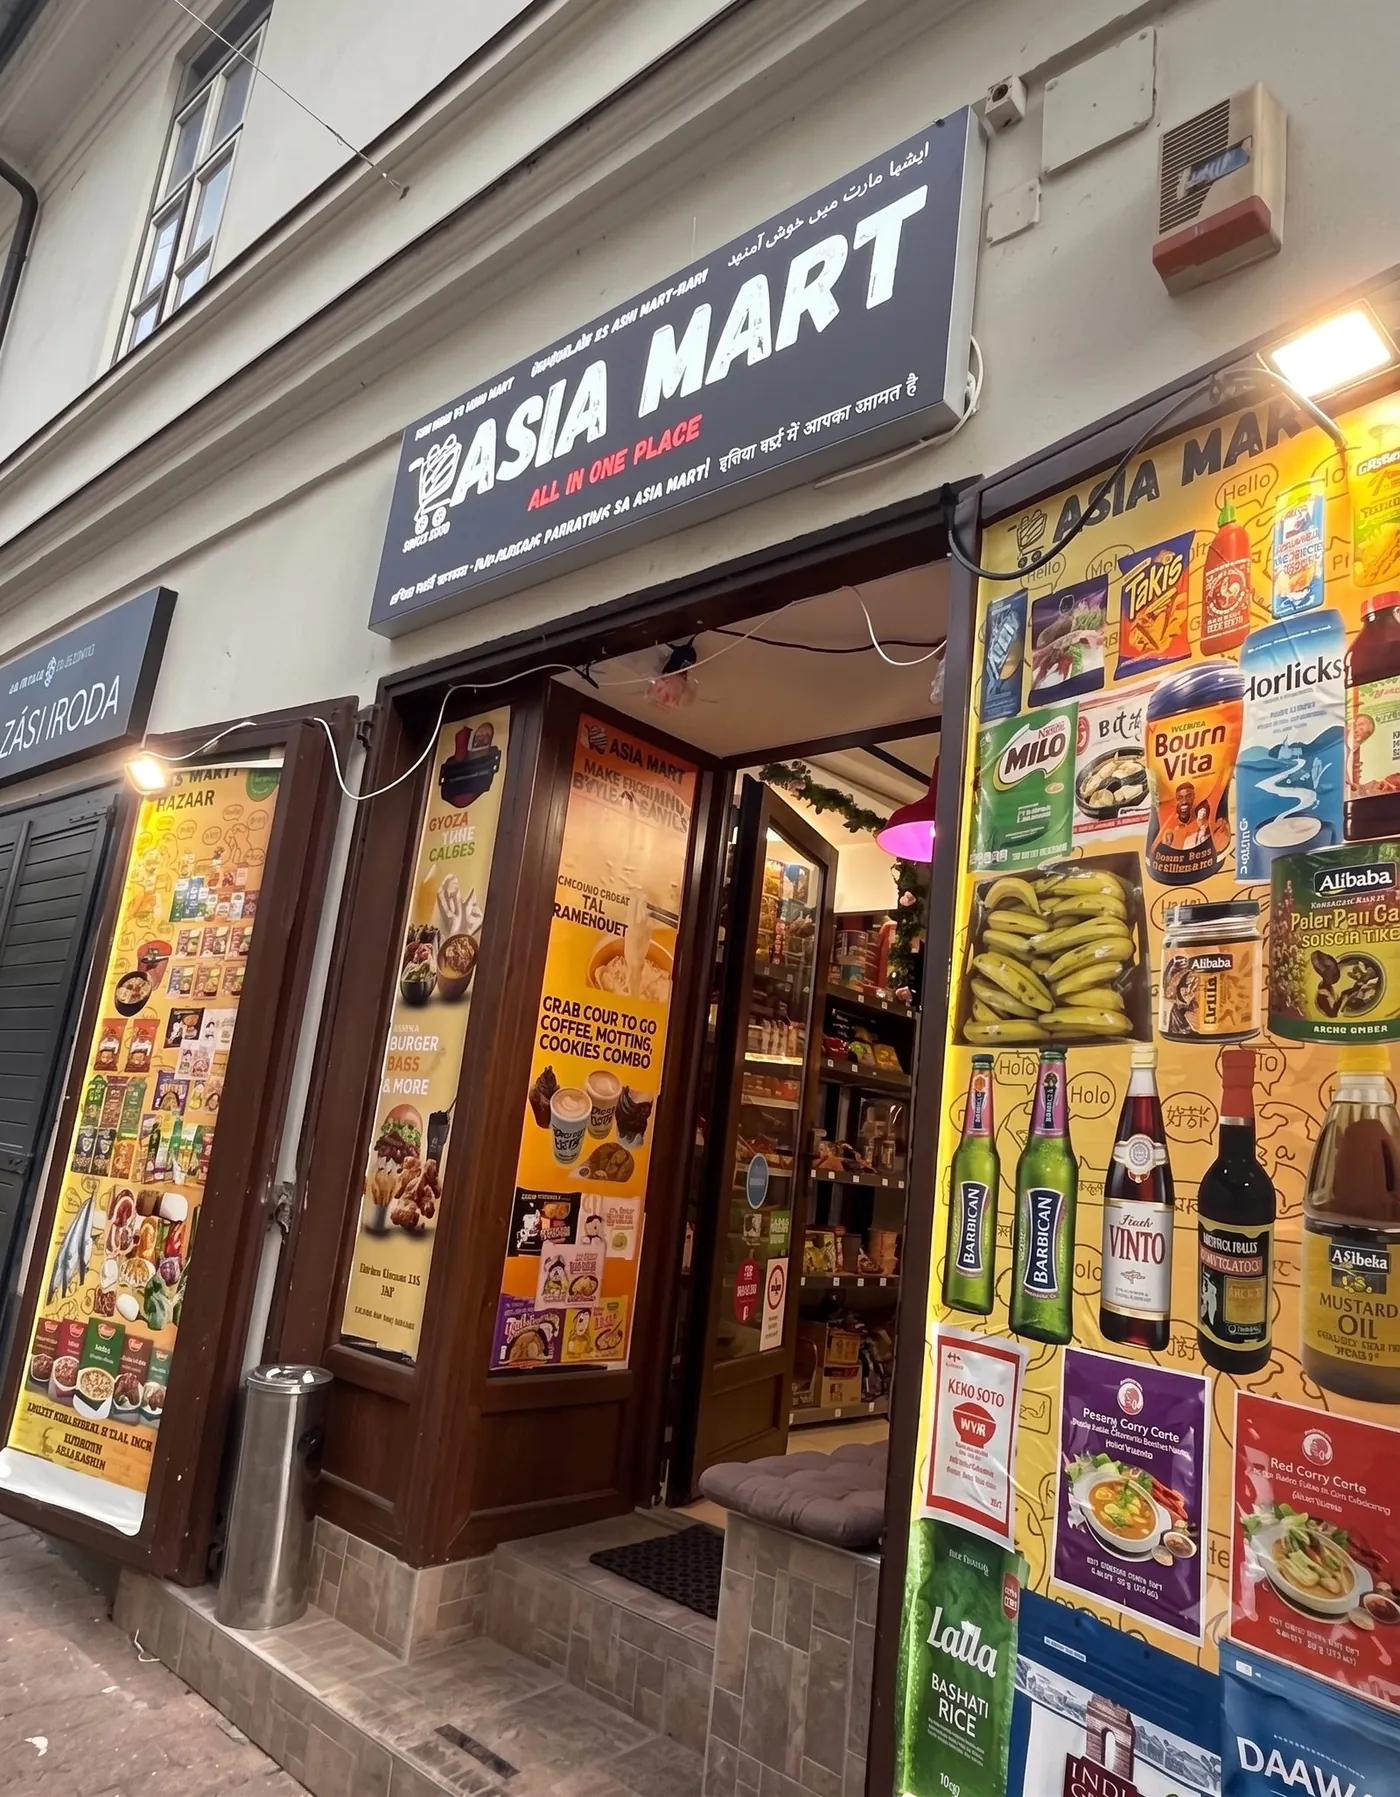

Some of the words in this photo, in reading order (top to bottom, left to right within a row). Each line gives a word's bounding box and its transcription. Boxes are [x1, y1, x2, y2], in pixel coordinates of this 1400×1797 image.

[449, 359, 608, 508] ASIA
[638, 184, 929, 419] MART
[905, 372, 920, 397] है
[527, 486, 560, 512] ALL
[563, 468, 584, 497] IN
[588, 455, 629, 485] ONE
[633, 413, 703, 466] PLACE
[613, 496, 630, 515] SA
[632, 486, 663, 509] ASIA
[1223, 472, 1272, 501] Hello
[45, 674, 121, 741] IRODA
[1004, 732, 1067, 776] MILO
[1155, 724, 1227, 758] Bourn
[584, 759, 622, 788] MAKE
[608, 738, 643, 768] ASIA
[646, 754, 687, 786] MART
[1164, 752, 1214, 782] Vita
[428, 812, 469, 833] GYOZA
[1318, 868, 1393, 893] Alibaba
[581, 894, 606, 915] TAL
[1190, 956, 1232, 971] Alibaba
[542, 995, 581, 1019] GRAB
[583, 1005, 619, 1027] COUR
[620, 1013, 638, 1030] TO
[639, 1018, 657, 1036] GO
[389, 1035, 440, 1053] BURGER
[540, 1014, 593, 1041] COFFEE,
[596, 1027, 654, 1056] MOTTING,
[387, 1054, 420, 1073] BASS
[539, 1033, 601, 1061] COOKIES
[602, 1046, 652, 1070] COMBO
[382, 1078, 392, 1094] &
[392, 1077, 430, 1097] MORE
[1070, 1085, 1111, 1105] Holo
[962, 1187, 981, 1266] BARBICAN
[1032, 1195, 1054, 1286] BARBICAN
[1108, 1224, 1167, 1266] VINTO
[1319, 1291, 1399, 1319] MUSTARD
[1338, 1314, 1378, 1340] OIL
[947, 1378, 976, 1401] KEKO
[976, 1387, 1006, 1409] SOTO
[1270, 1457, 1294, 1474] Red
[931, 1672, 989, 1720] BASHATI
[938, 1699, 977, 1739] RICE
[1236, 1735, 1373, 1797] DAAW
